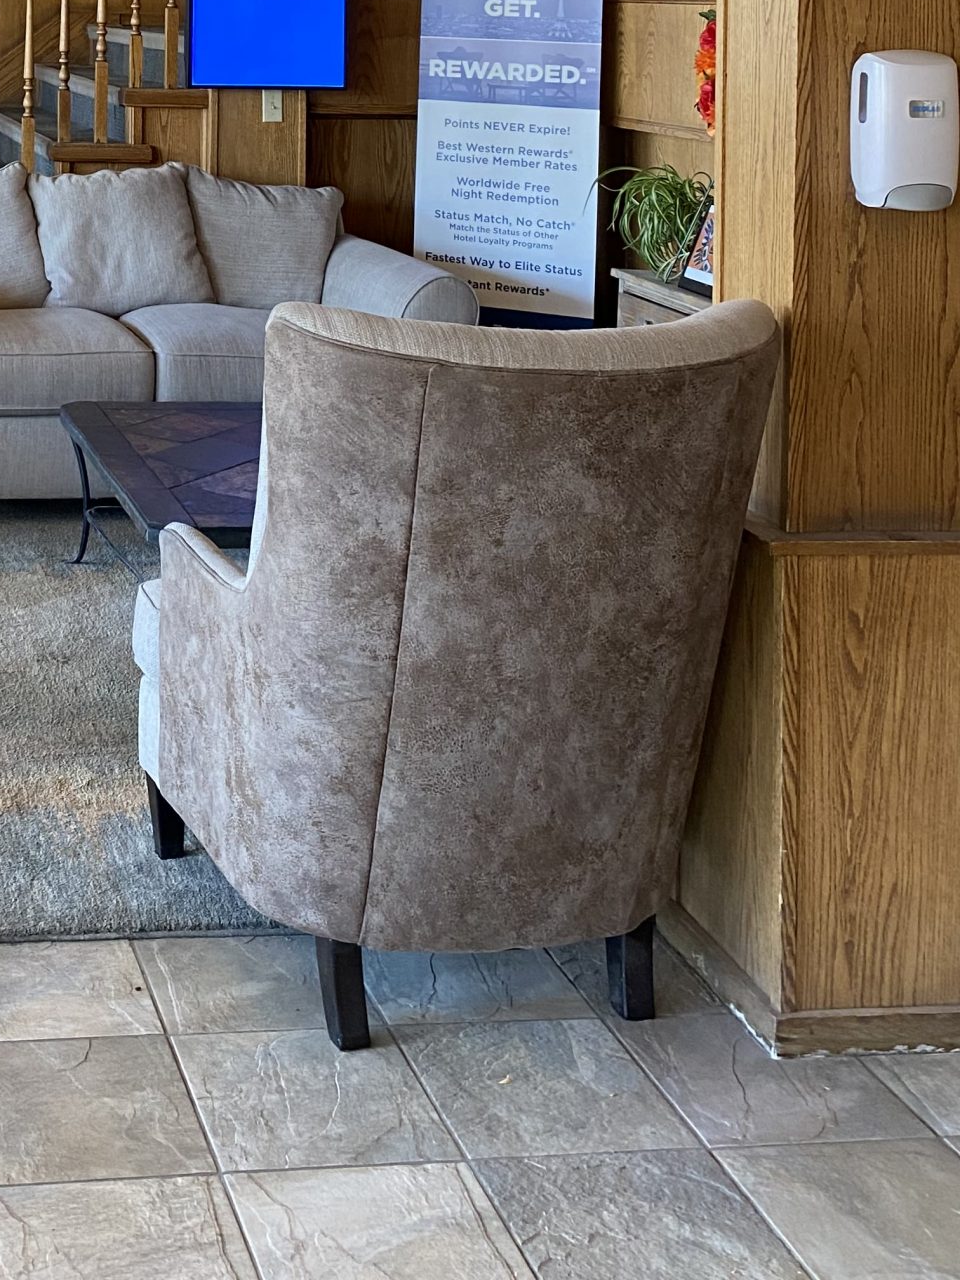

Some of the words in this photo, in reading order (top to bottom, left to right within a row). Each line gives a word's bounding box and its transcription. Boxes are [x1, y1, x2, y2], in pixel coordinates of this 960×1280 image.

[444, 118, 480, 129] Points
[483, 121, 525, 133] NEVER
[529, 124, 571, 136] Expire!
[437, 140, 462, 151] Best
[466, 142, 514, 155] Western
[436, 152, 489, 165] Exclusive
[492, 157, 541, 169] Member
[544, 160, 578, 172] Rates
[456, 176, 521, 191] Worldwide
[524, 181, 551, 193] Free
[451, 188, 483, 200] Night
[486, 191, 560, 207] Redemption
[434, 209, 470, 222] Status
[474, 213, 513, 227] Match,
[516, 217, 533, 227] No
[449, 223, 474, 233] Match
[476, 226, 491, 234] the
[493, 227, 520, 237] Status
[522, 230, 531, 238] of
[533, 231, 559, 241] Other
[453, 233, 476, 243] Hotel
[478, 236, 510, 247] Loyalty
[512, 240, 553, 251] Programs
[425, 251, 466, 266] Fastest
[469, 255, 495, 270] Way
[498, 261, 511, 270] to
[514, 261, 541, 273] Elite
[544, 264, 583, 277] Status
